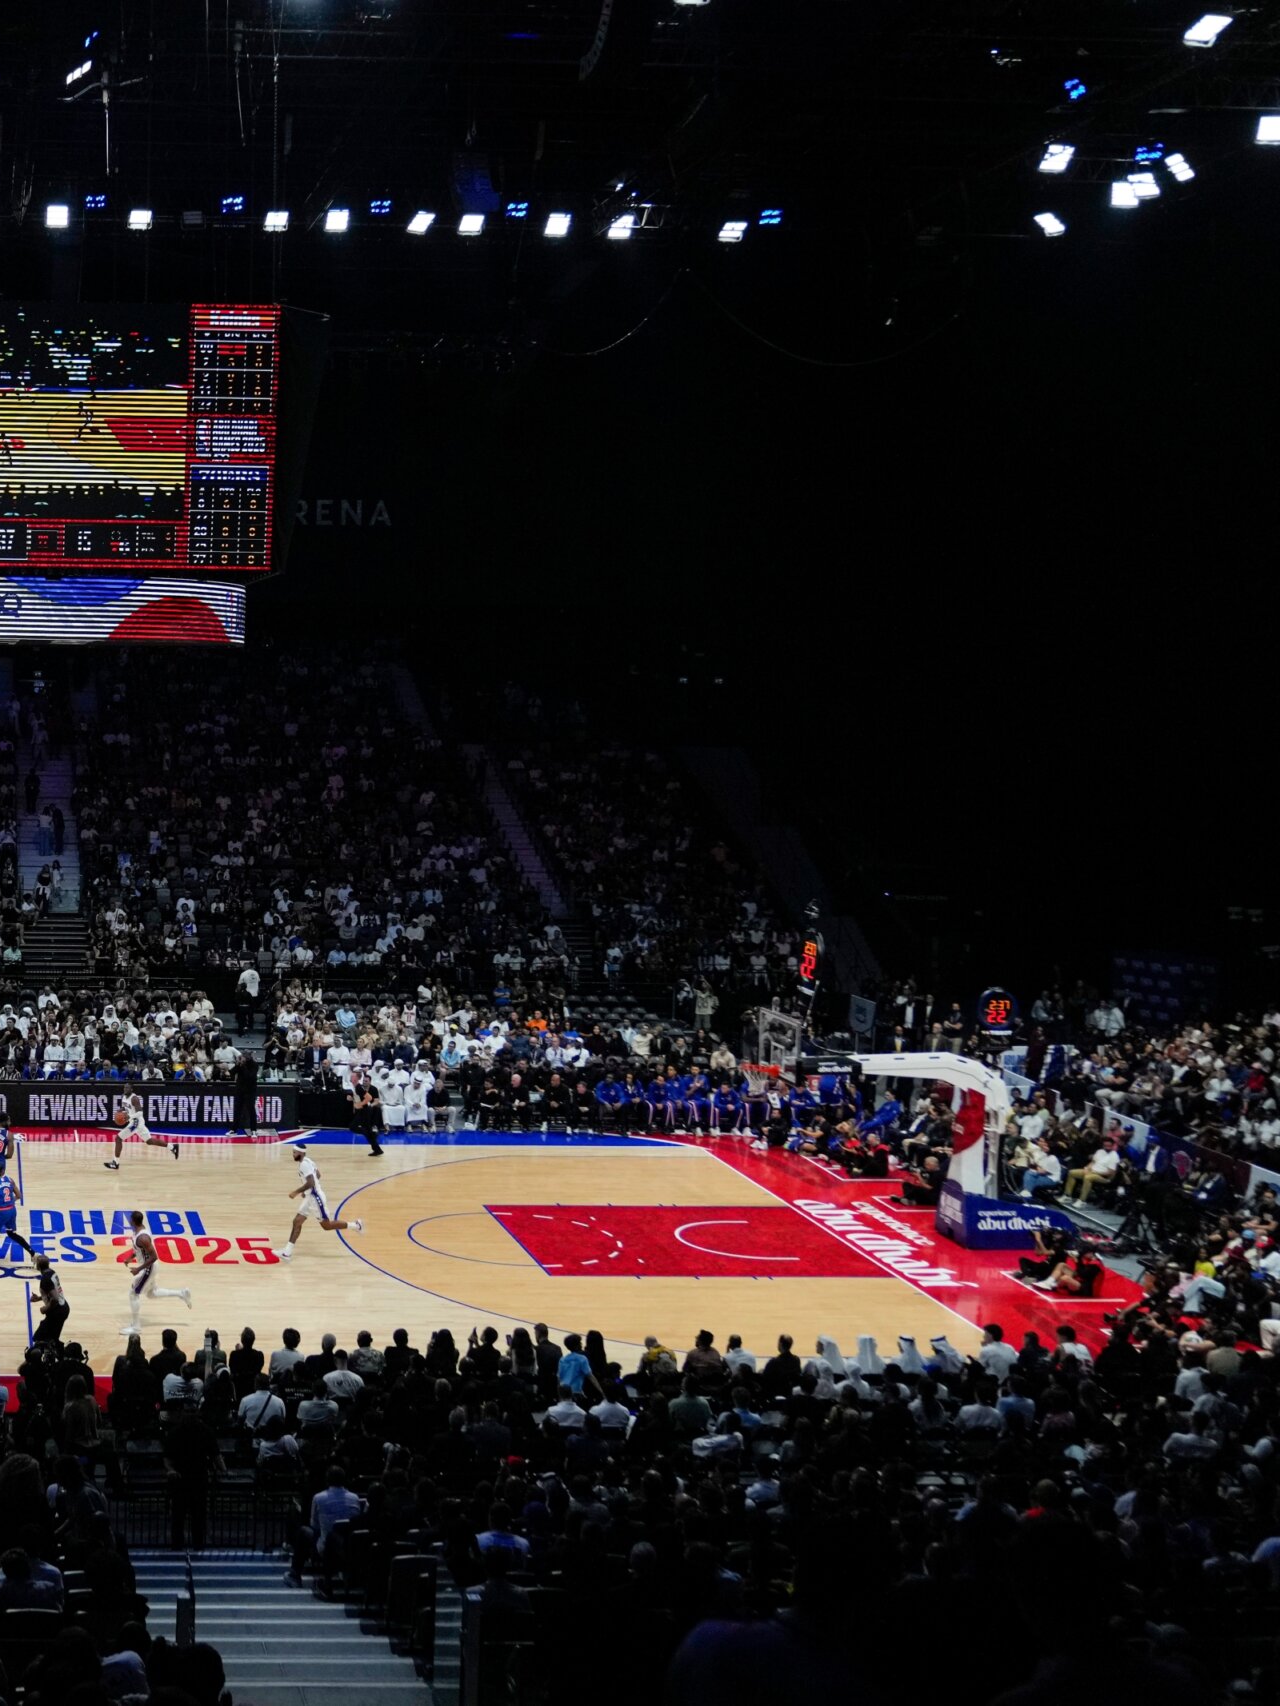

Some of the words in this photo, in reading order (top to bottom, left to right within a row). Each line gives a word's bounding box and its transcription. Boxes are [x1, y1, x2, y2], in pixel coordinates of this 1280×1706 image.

[295, 499, 392, 526] RENA
[28, 1094, 108, 1121] REWARDS
[148, 1095, 199, 1122] EVERY
[203, 1096, 234, 1122] FAN
[3, 1187, 11, 1202] 2
[29, 1210, 207, 1236] DHABI
[793, 1199, 873, 1231] abu
[977, 1218, 1003, 1231] abu
[111, 1237, 281, 1265] 2025
